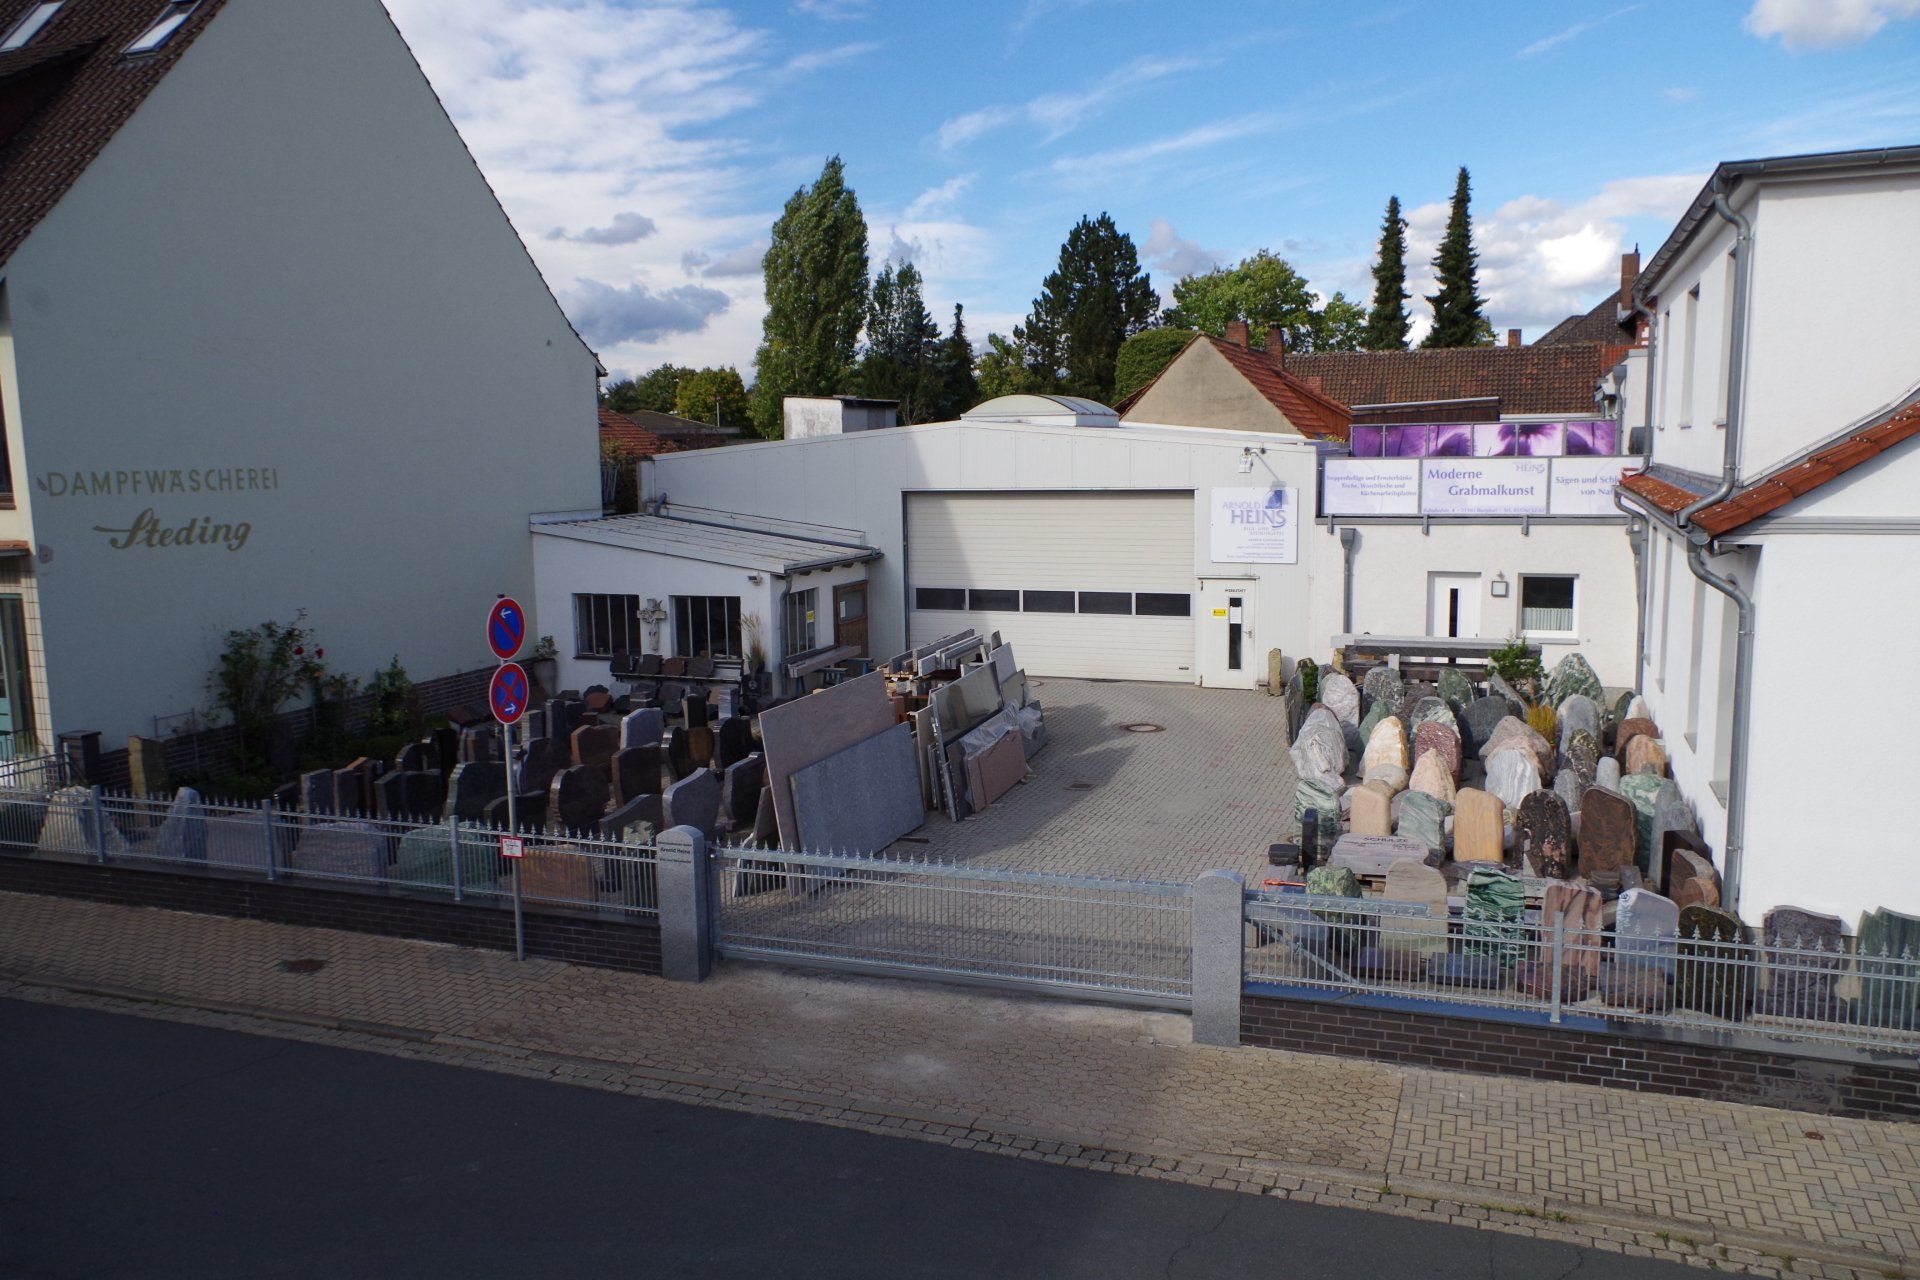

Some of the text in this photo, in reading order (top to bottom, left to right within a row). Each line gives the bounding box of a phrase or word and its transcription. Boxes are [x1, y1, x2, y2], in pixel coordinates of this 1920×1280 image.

[1427, 468, 1483, 480] Moderne
[1515, 463, 1545, 474] HEINS
[47, 467, 279, 497] DAMPFWÄSCHEREI
[1555, 475, 1579, 485] Sägen
[1581, 475, 1598, 484] und
[1448, 484, 1534, 496] Grabmalkunst
[1580, 488, 1595, 496] von
[1222, 500, 1261, 510] ARNOLD
[1230, 509, 1287, 528] HEINS
[92, 507, 252, 551] Steding
